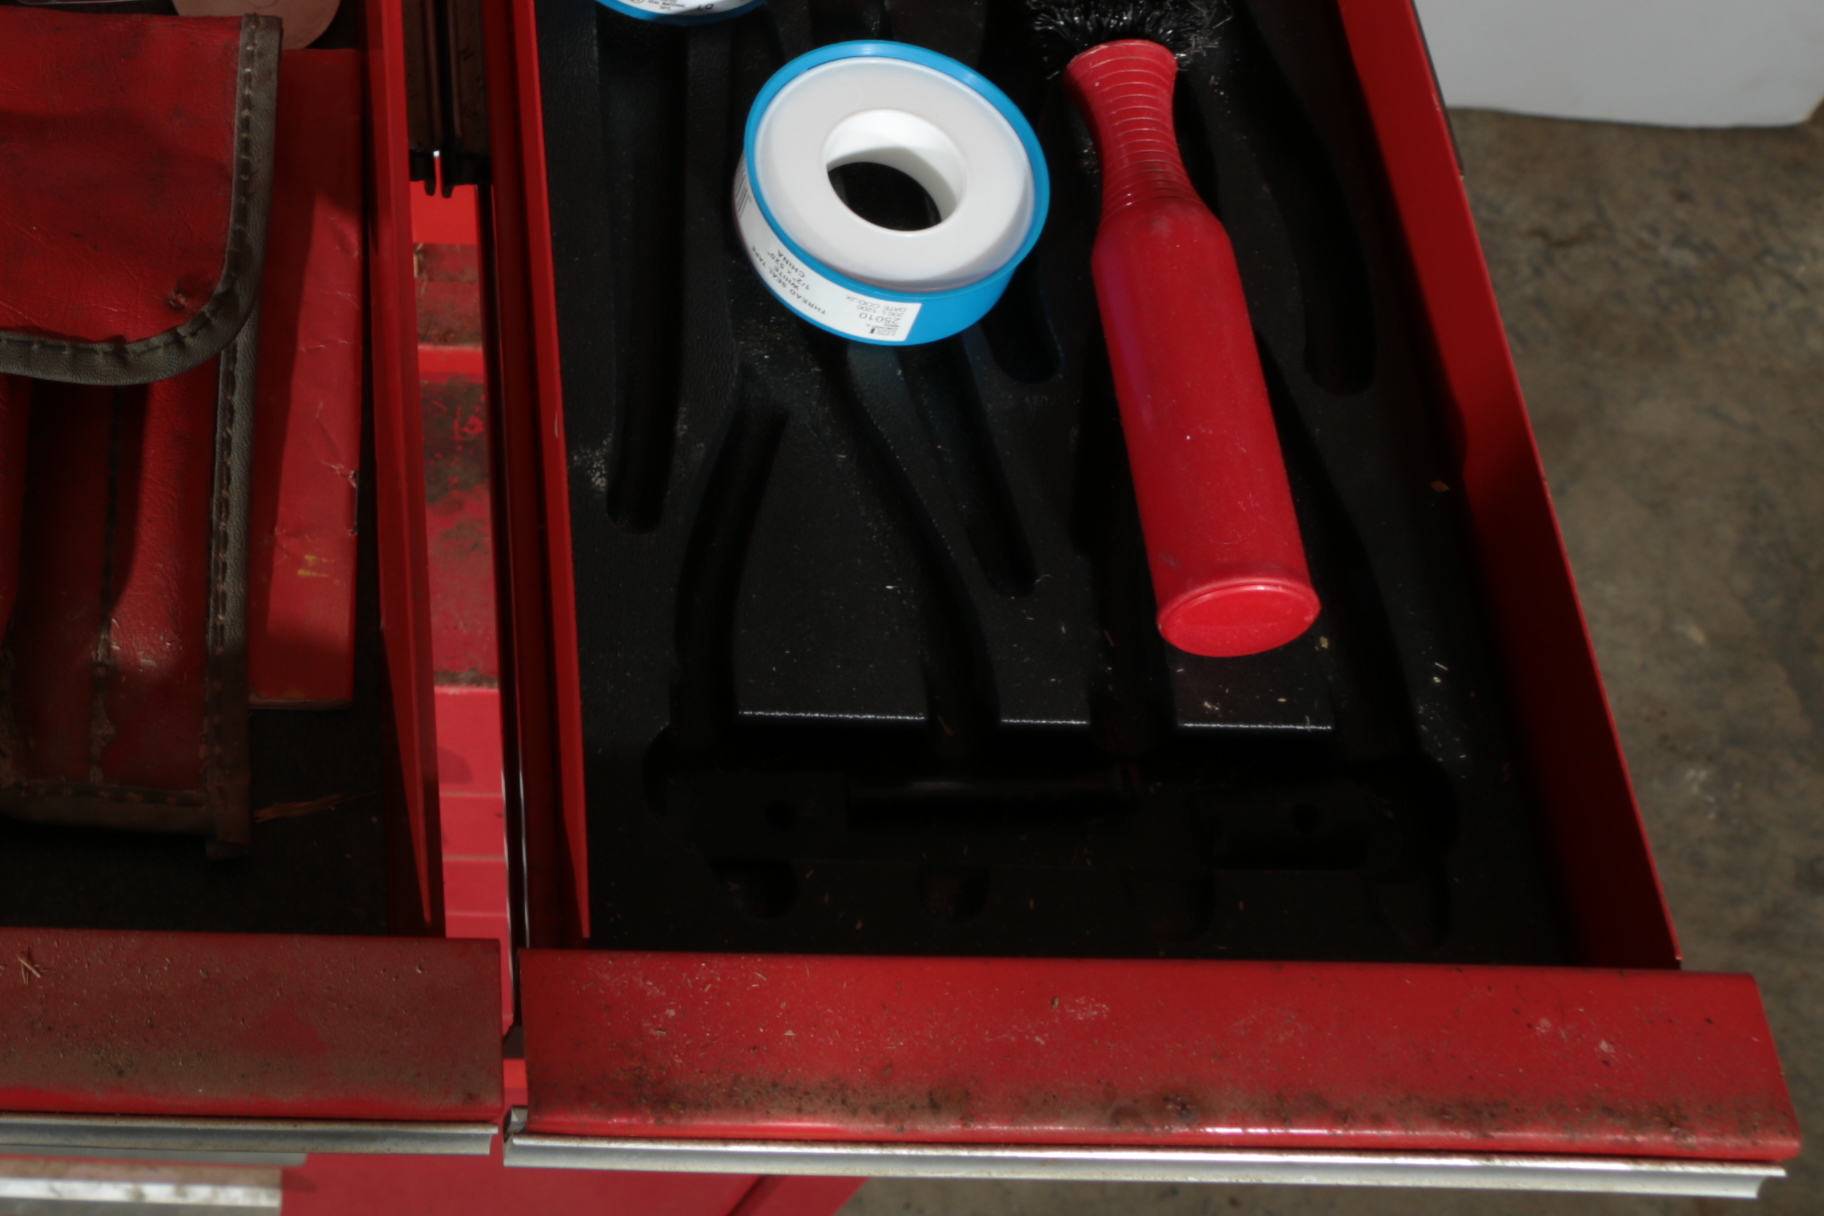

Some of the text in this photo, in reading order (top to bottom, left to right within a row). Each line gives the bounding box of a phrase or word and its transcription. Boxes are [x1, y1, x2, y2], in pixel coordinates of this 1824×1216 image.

[775, 263, 799, 290] WHITE
[776, 249, 806, 279] CHINA
[750, 244, 827, 316] THREAD SEAL TAPE
[858, 312, 900, 325] 25010
